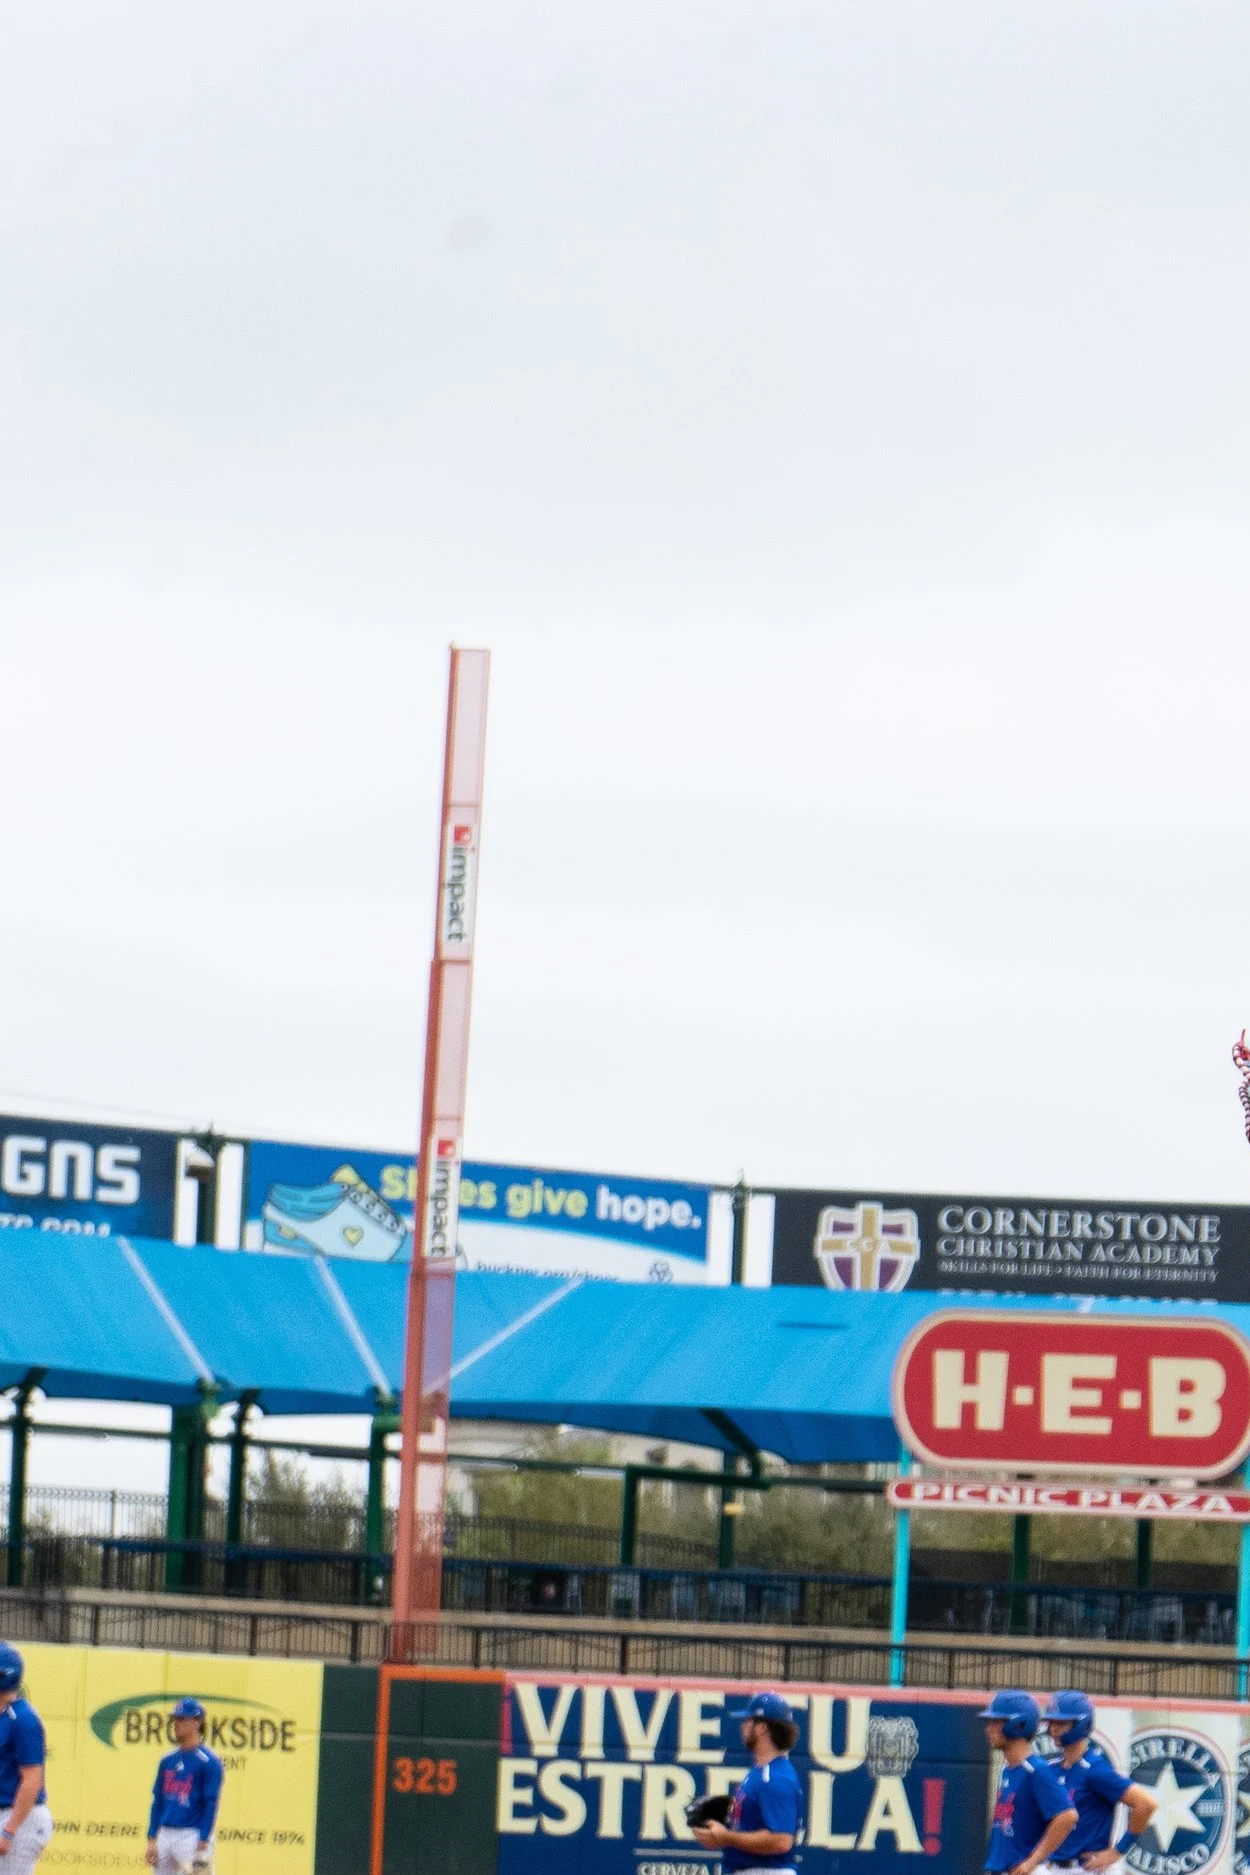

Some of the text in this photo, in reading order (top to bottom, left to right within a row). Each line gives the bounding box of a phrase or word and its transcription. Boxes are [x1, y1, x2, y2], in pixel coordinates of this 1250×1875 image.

[446, 846, 470, 943] impact
[427, 1161, 452, 1257] impact
[506, 1178, 588, 1219] give
[595, 1183, 702, 1231] hope.
[937, 1204, 1222, 1243] CORNERSTONE
[936, 1236, 1220, 1266] CHRISTIAN ACADEMY
[992, 1261, 1018, 1275] FOR
[1113, 1267, 1142, 1281] FOR
[914, 1482, 1235, 1514] PICNIC PLAZA
[513, 1683, 727, 1764] VIVE
[393, 1757, 457, 1796] 325
[216, 1829, 265, 1844] SINCE
